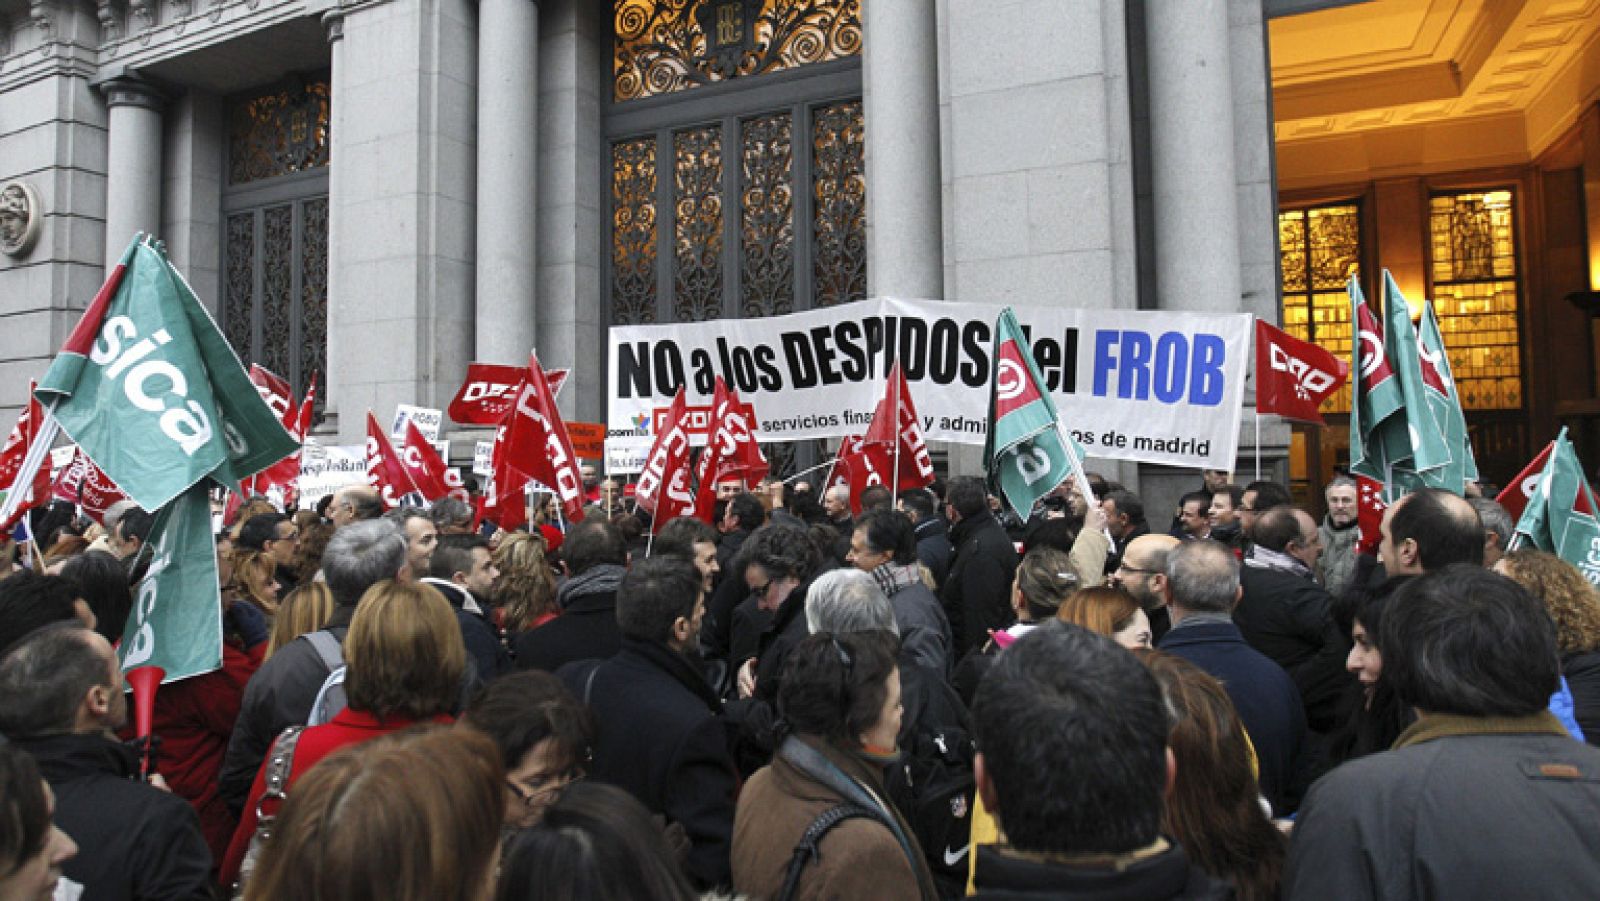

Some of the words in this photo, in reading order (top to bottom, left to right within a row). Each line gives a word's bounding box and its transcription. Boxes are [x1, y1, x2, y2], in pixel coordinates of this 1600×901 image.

[617, 339, 686, 398] NO
[691, 348, 714, 396] a
[716, 337, 782, 393] los
[780, 316, 990, 389] DESPIDOS
[1092, 328, 1226, 407] FROB
[762, 413, 838, 433] servicios
[843, 409, 876, 426] fina
[924, 415, 934, 432] y
[939, 416, 987, 434] admi
[1101, 430, 1128, 449] de
[1133, 435, 1211, 457] madrid
